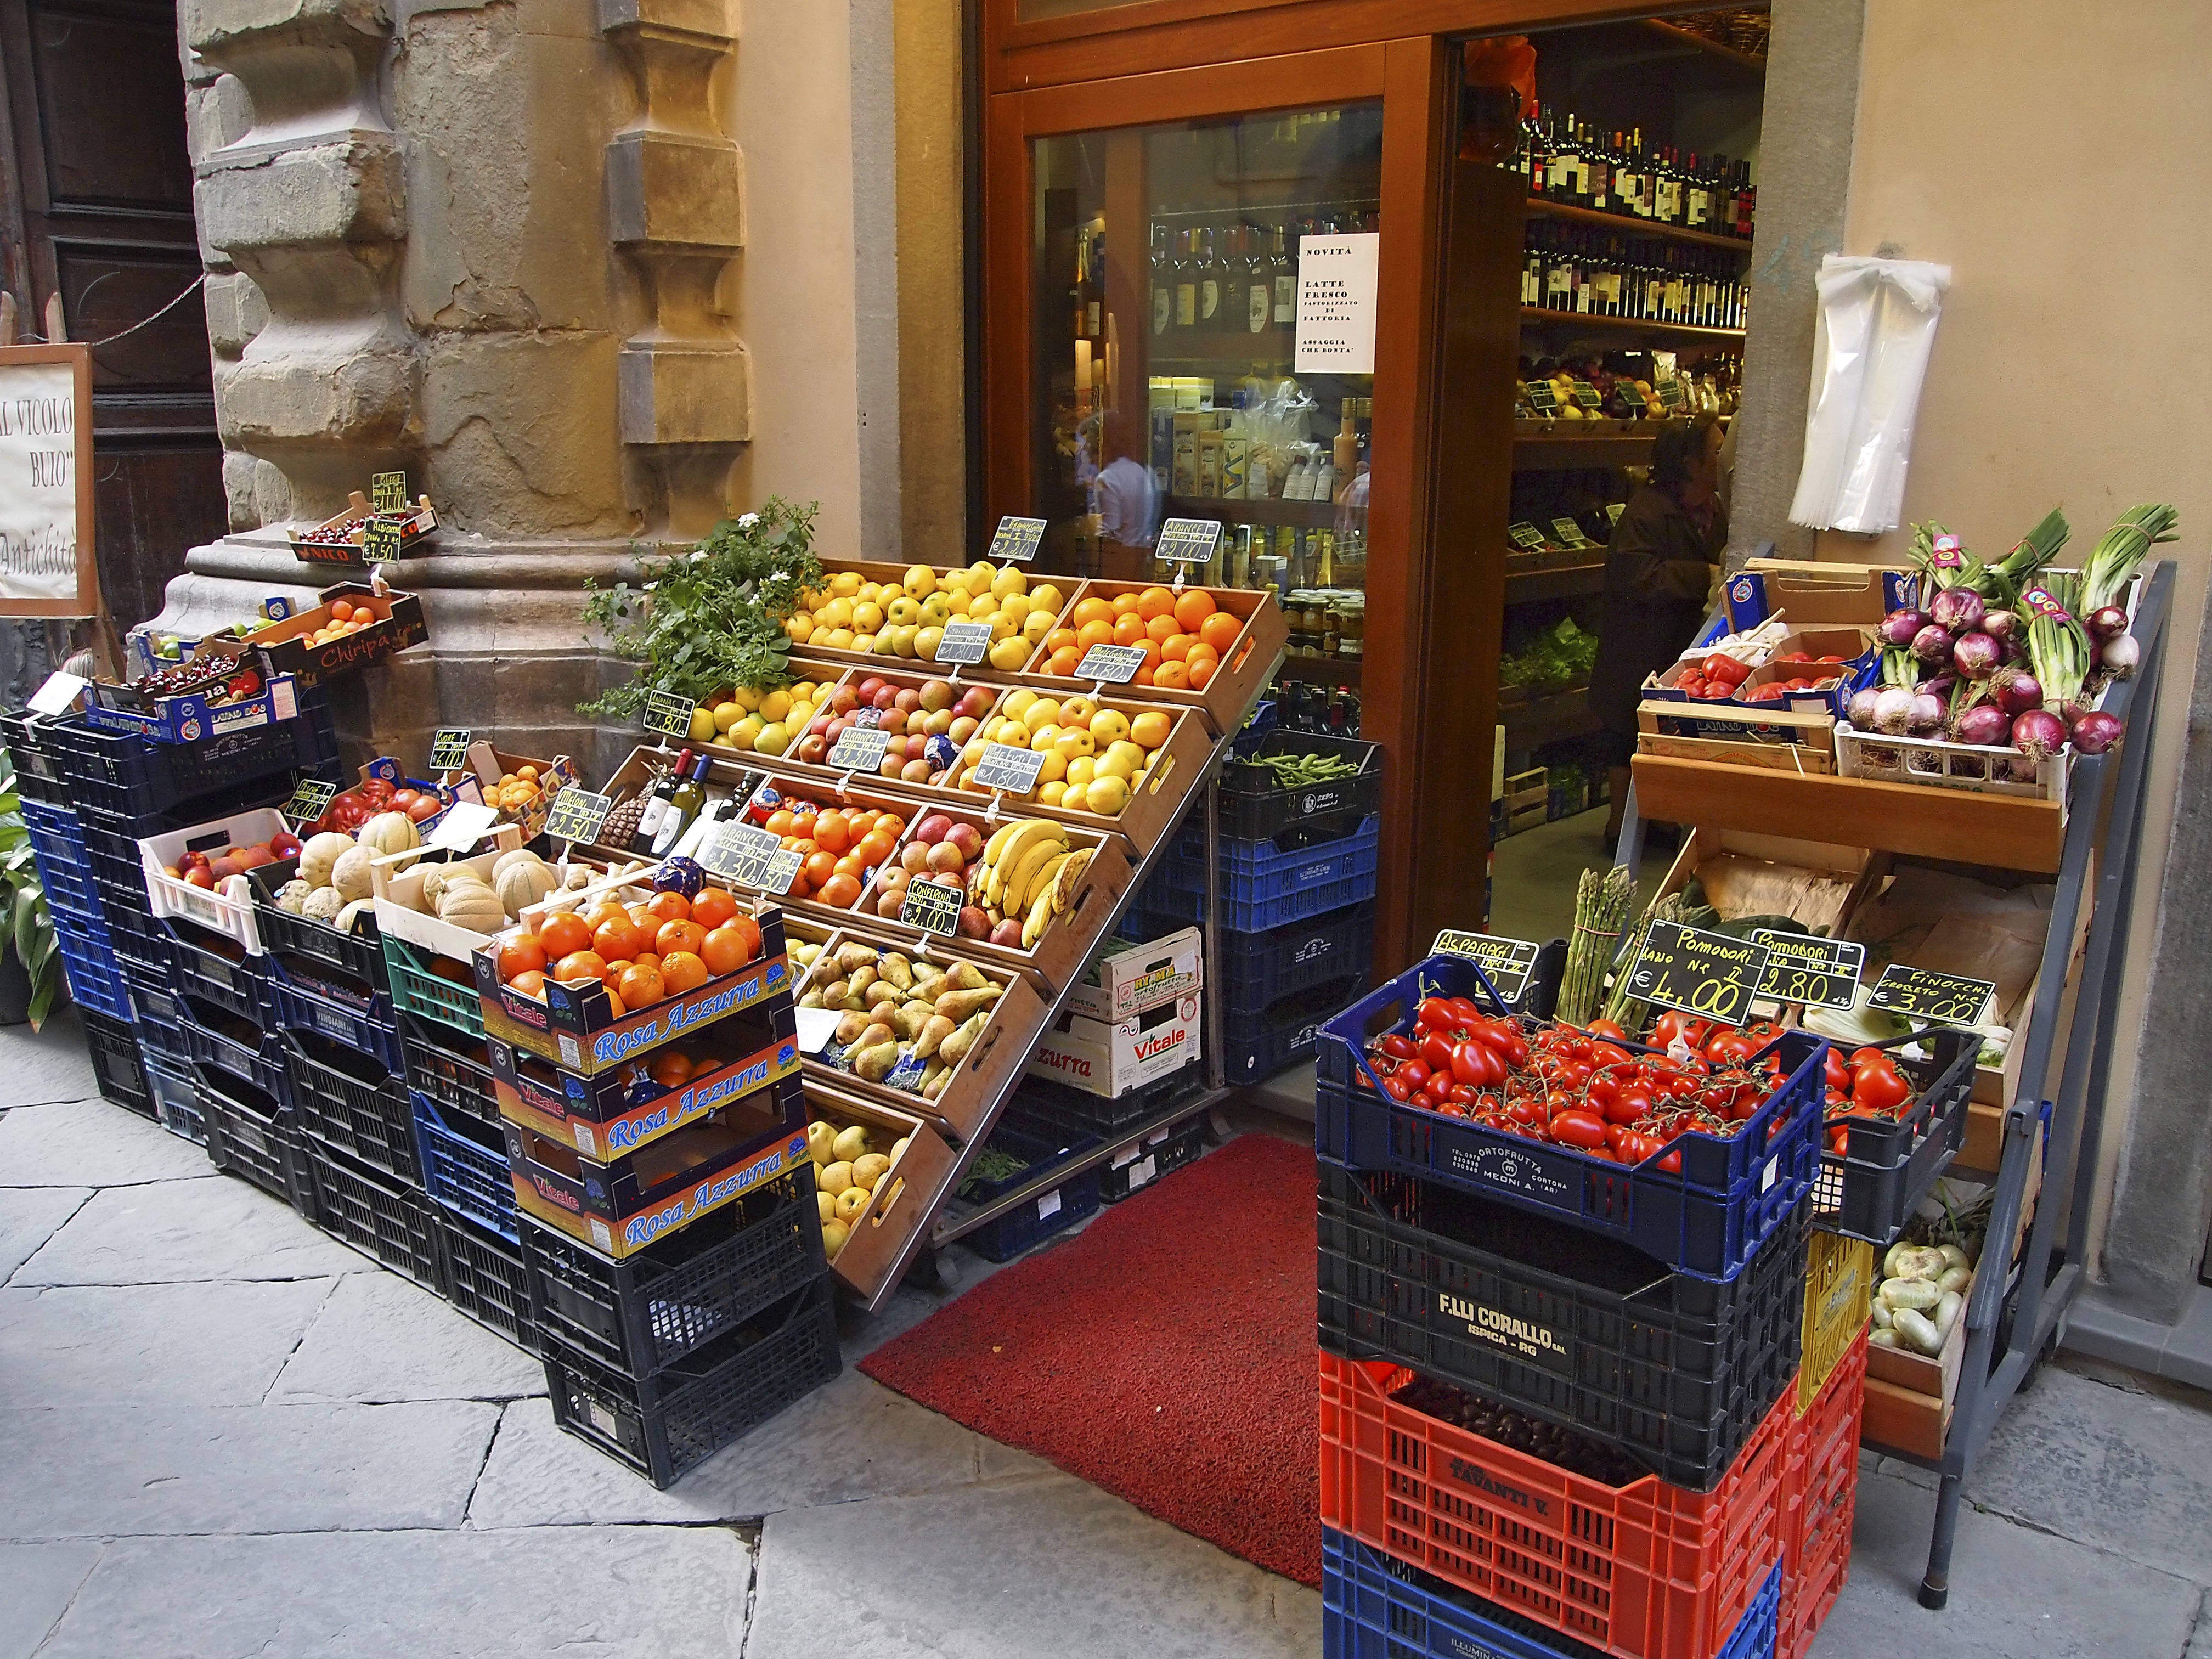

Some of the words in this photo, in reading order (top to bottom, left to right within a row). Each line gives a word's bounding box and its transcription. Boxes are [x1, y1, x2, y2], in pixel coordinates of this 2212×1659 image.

[1306, 246, 1352, 256] NOVITÀ
[17, 398, 72, 435] VICOLO
[1166, 521, 1203, 533] ARANCE
[370, 543, 393, 561] 7,50
[993, 542, 1001, 550] €
[998, 540, 1030, 556] 2,20
[1164, 541, 1201, 558] 2,00
[945, 644, 974, 660] 1,80
[1088, 663, 1124, 678] 1,80
[651, 692, 676, 708] ANANAS
[650, 714, 681, 733] 2,80
[436, 751, 460, 767] 6,00
[837, 749, 872, 768] 2,20
[983, 767, 1020, 787] 1,80
[292, 802, 318, 819] 6,00
[552, 814, 590, 839] 2,50
[721, 824, 762, 847] ARANCE
[709, 850, 757, 882] 2,30
[909, 906, 945, 933] 2,00
[1634, 970, 1653, 988] €
[1650, 970, 1739, 1015] 4,00
[1759, 967, 1828, 1003] 2,80
[1879, 979, 1939, 996] GROSSETO
[500, 993, 548, 1028] Vitale
[1874, 992, 1889, 1002] €
[1888, 993, 1974, 1020] 3,00
[594, 1025, 657, 1064] Rosa
[660, 976, 760, 1040] Azzurra
[1133, 1029, 1186, 1061] Vitale
[518, 1080, 565, 1118] Vitale
[609, 1105, 668, 1150] Rosa
[672, 1058, 769, 1125] Azzurra
[1478, 1147, 1542, 1175] ORTOFRUTTA
[533, 1173, 580, 1211] Vitale
[1483, 1170, 1520, 1187] MEONI
[1524, 1183, 1535, 1191] A.
[1532, 1174, 1567, 1190] CORTONA
[1541, 1184, 1558, 1194] (AR)
[625, 1201, 685, 1248] Rosa
[687, 1150, 782, 1220] Azzurra
[1440, 1293, 1475, 1322] F.LLI
[1477, 1306, 1553, 1349] CORALLO
[1468, 1323, 1508, 1346] ISPICA
[1519, 1341, 1537, 1357] RG
[1452, 1463, 1529, 1508] TAVANTI
[1534, 1498, 1548, 1516] V.
